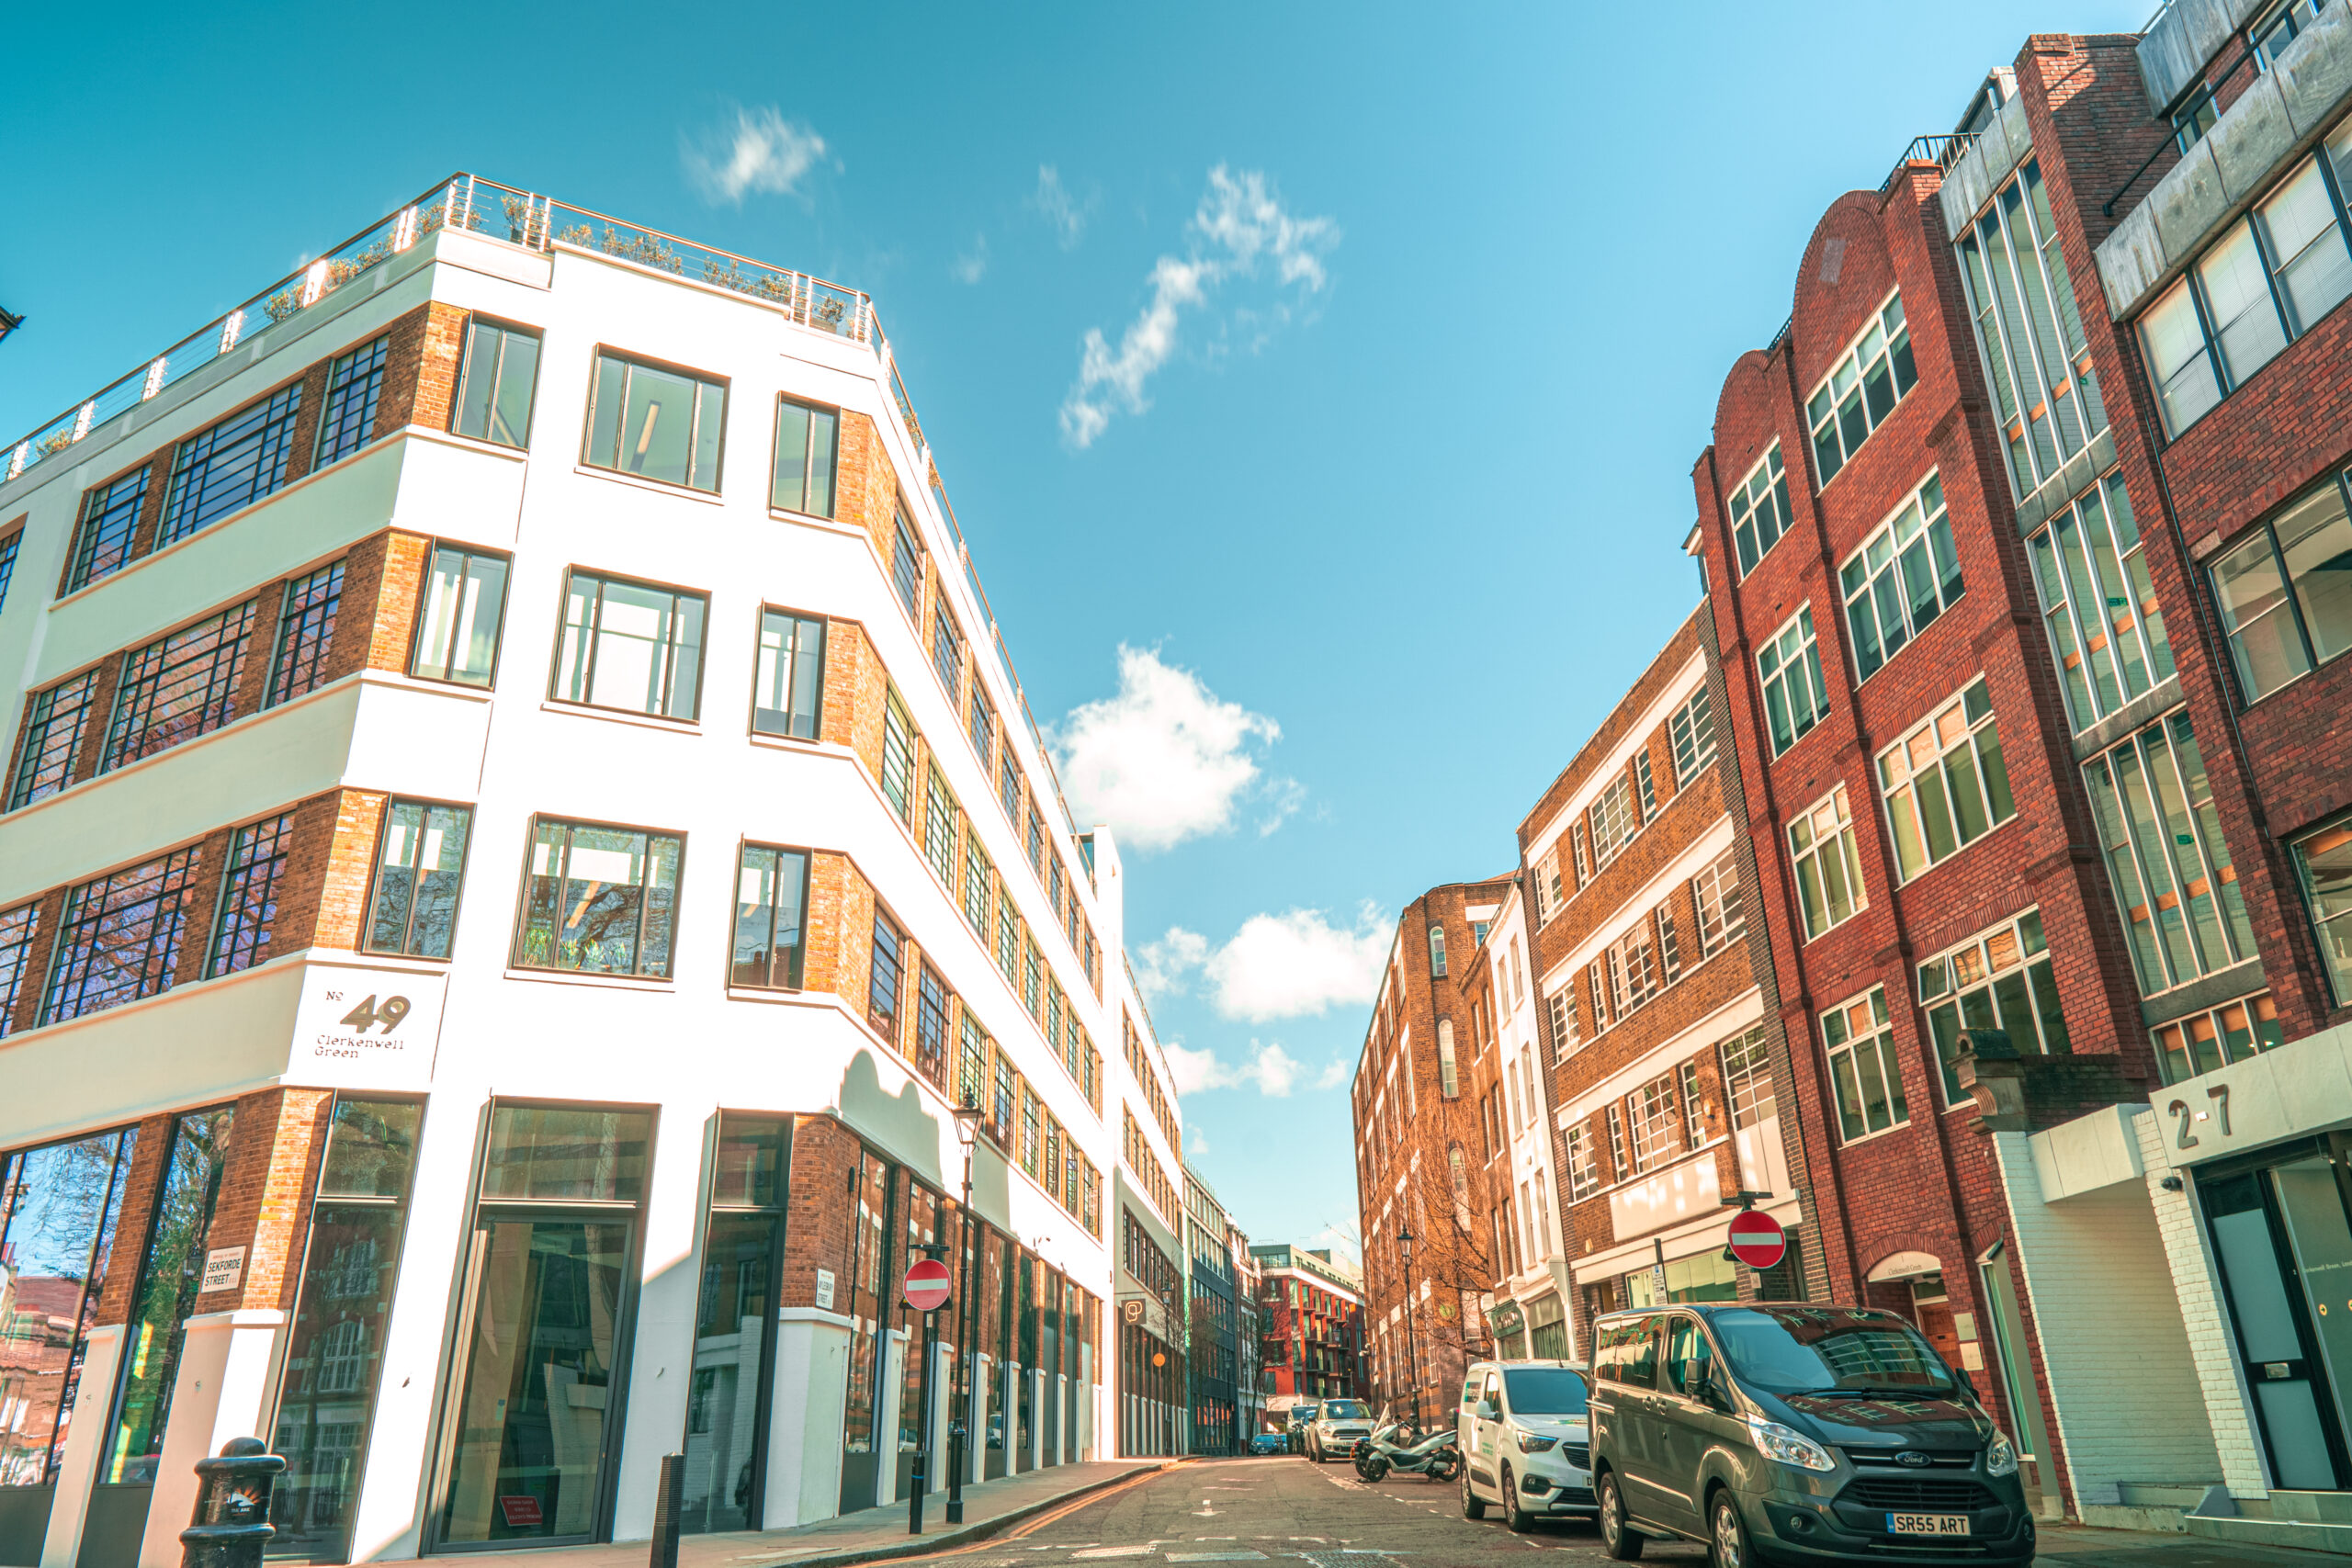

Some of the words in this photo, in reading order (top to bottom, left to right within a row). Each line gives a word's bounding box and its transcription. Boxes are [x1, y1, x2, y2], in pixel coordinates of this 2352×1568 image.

[340, 994, 411, 1034] 49
[317, 1034, 403, 1049] Clerkenwell
[315, 1046, 358, 1058] Green
[208, 1258, 242, 1272] SEKFORDE
[205, 1273, 231, 1287] STREET
[1904, 1453, 1924, 1463] Ford
[1895, 1516, 1935, 1532] SR55
[1939, 1517, 1966, 1534] ART
